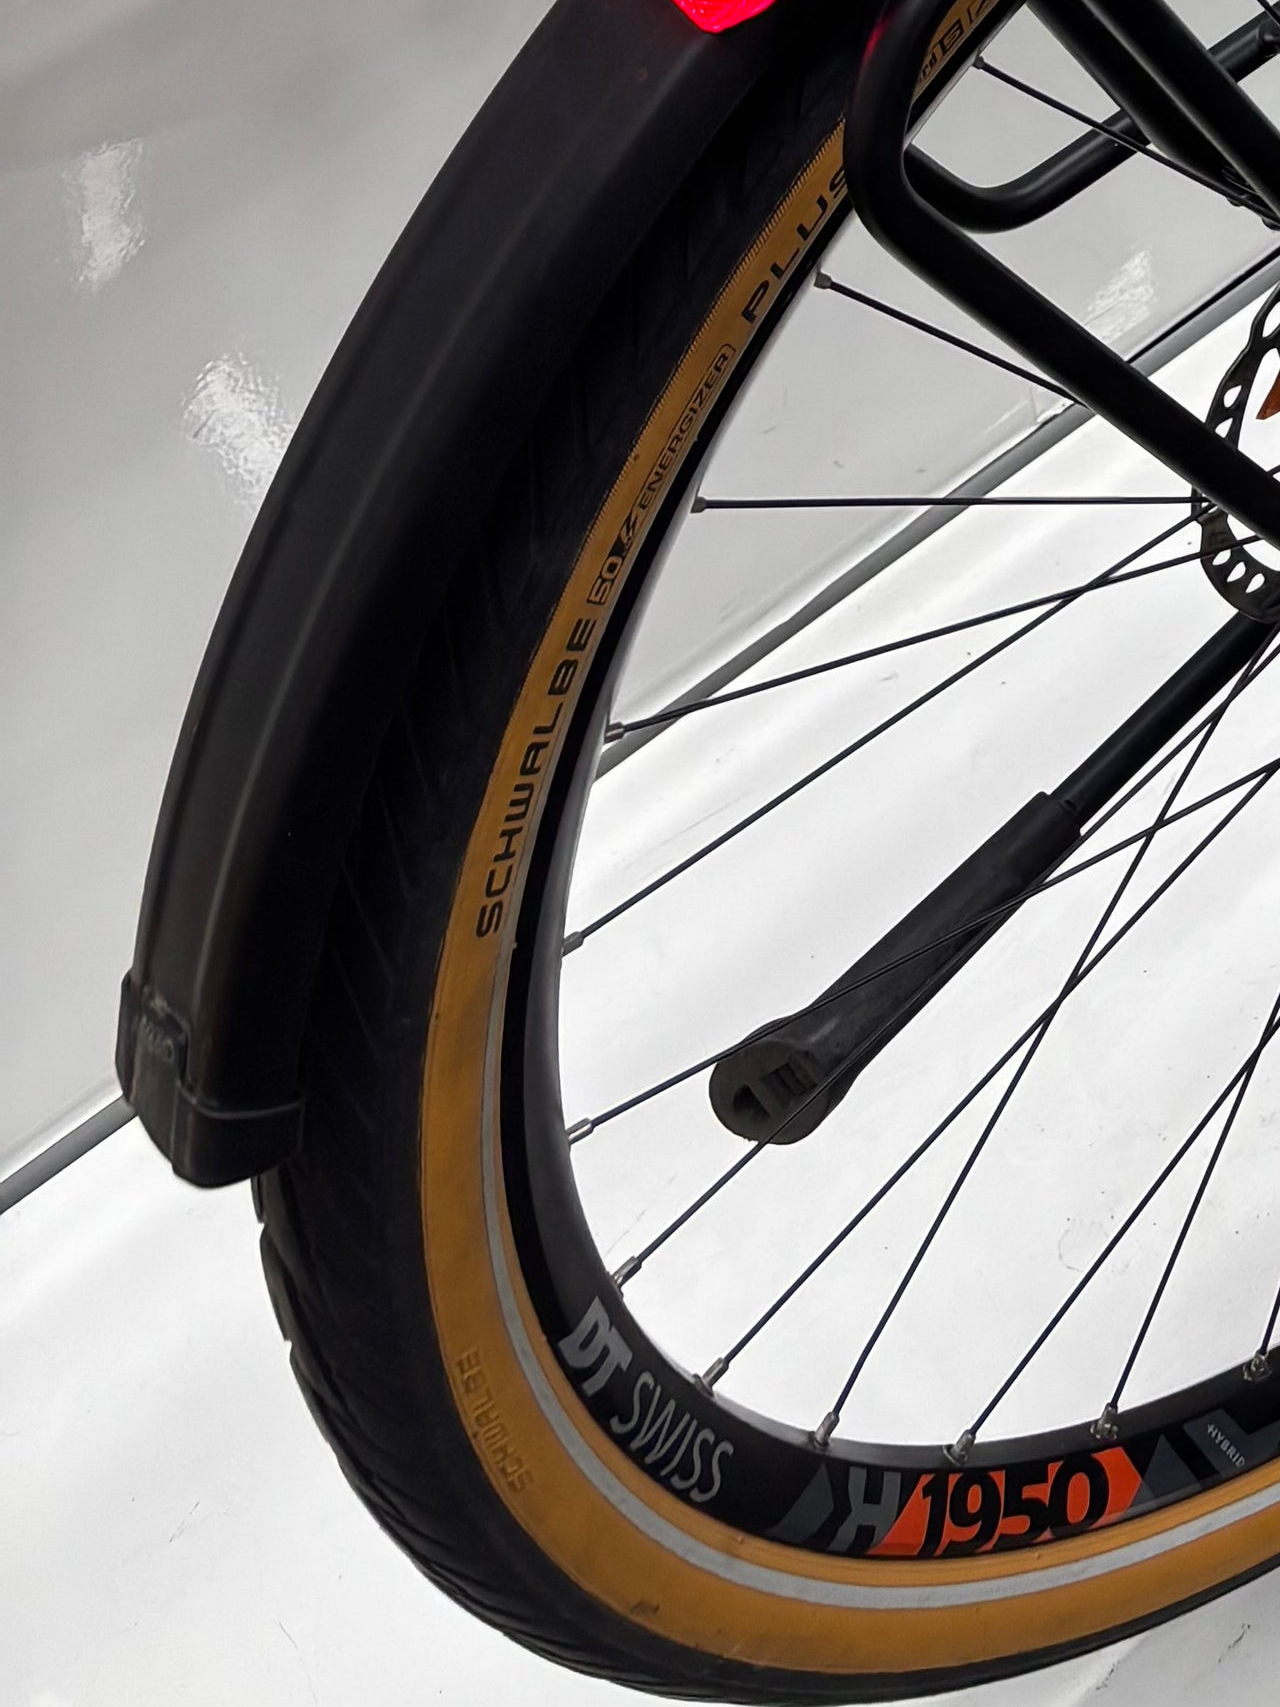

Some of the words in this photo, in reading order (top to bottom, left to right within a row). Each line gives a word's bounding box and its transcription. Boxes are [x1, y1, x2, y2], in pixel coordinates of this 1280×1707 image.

[475, 618, 591, 940] SCHWALBE
[638, 352, 731, 511] ENERGIZER
[558, 1296, 634, 1398] DT
[608, 1370, 735, 1503] SWISS
[1205, 1421, 1248, 1469] HYBRID
[922, 1450, 1110, 1557] 1950
